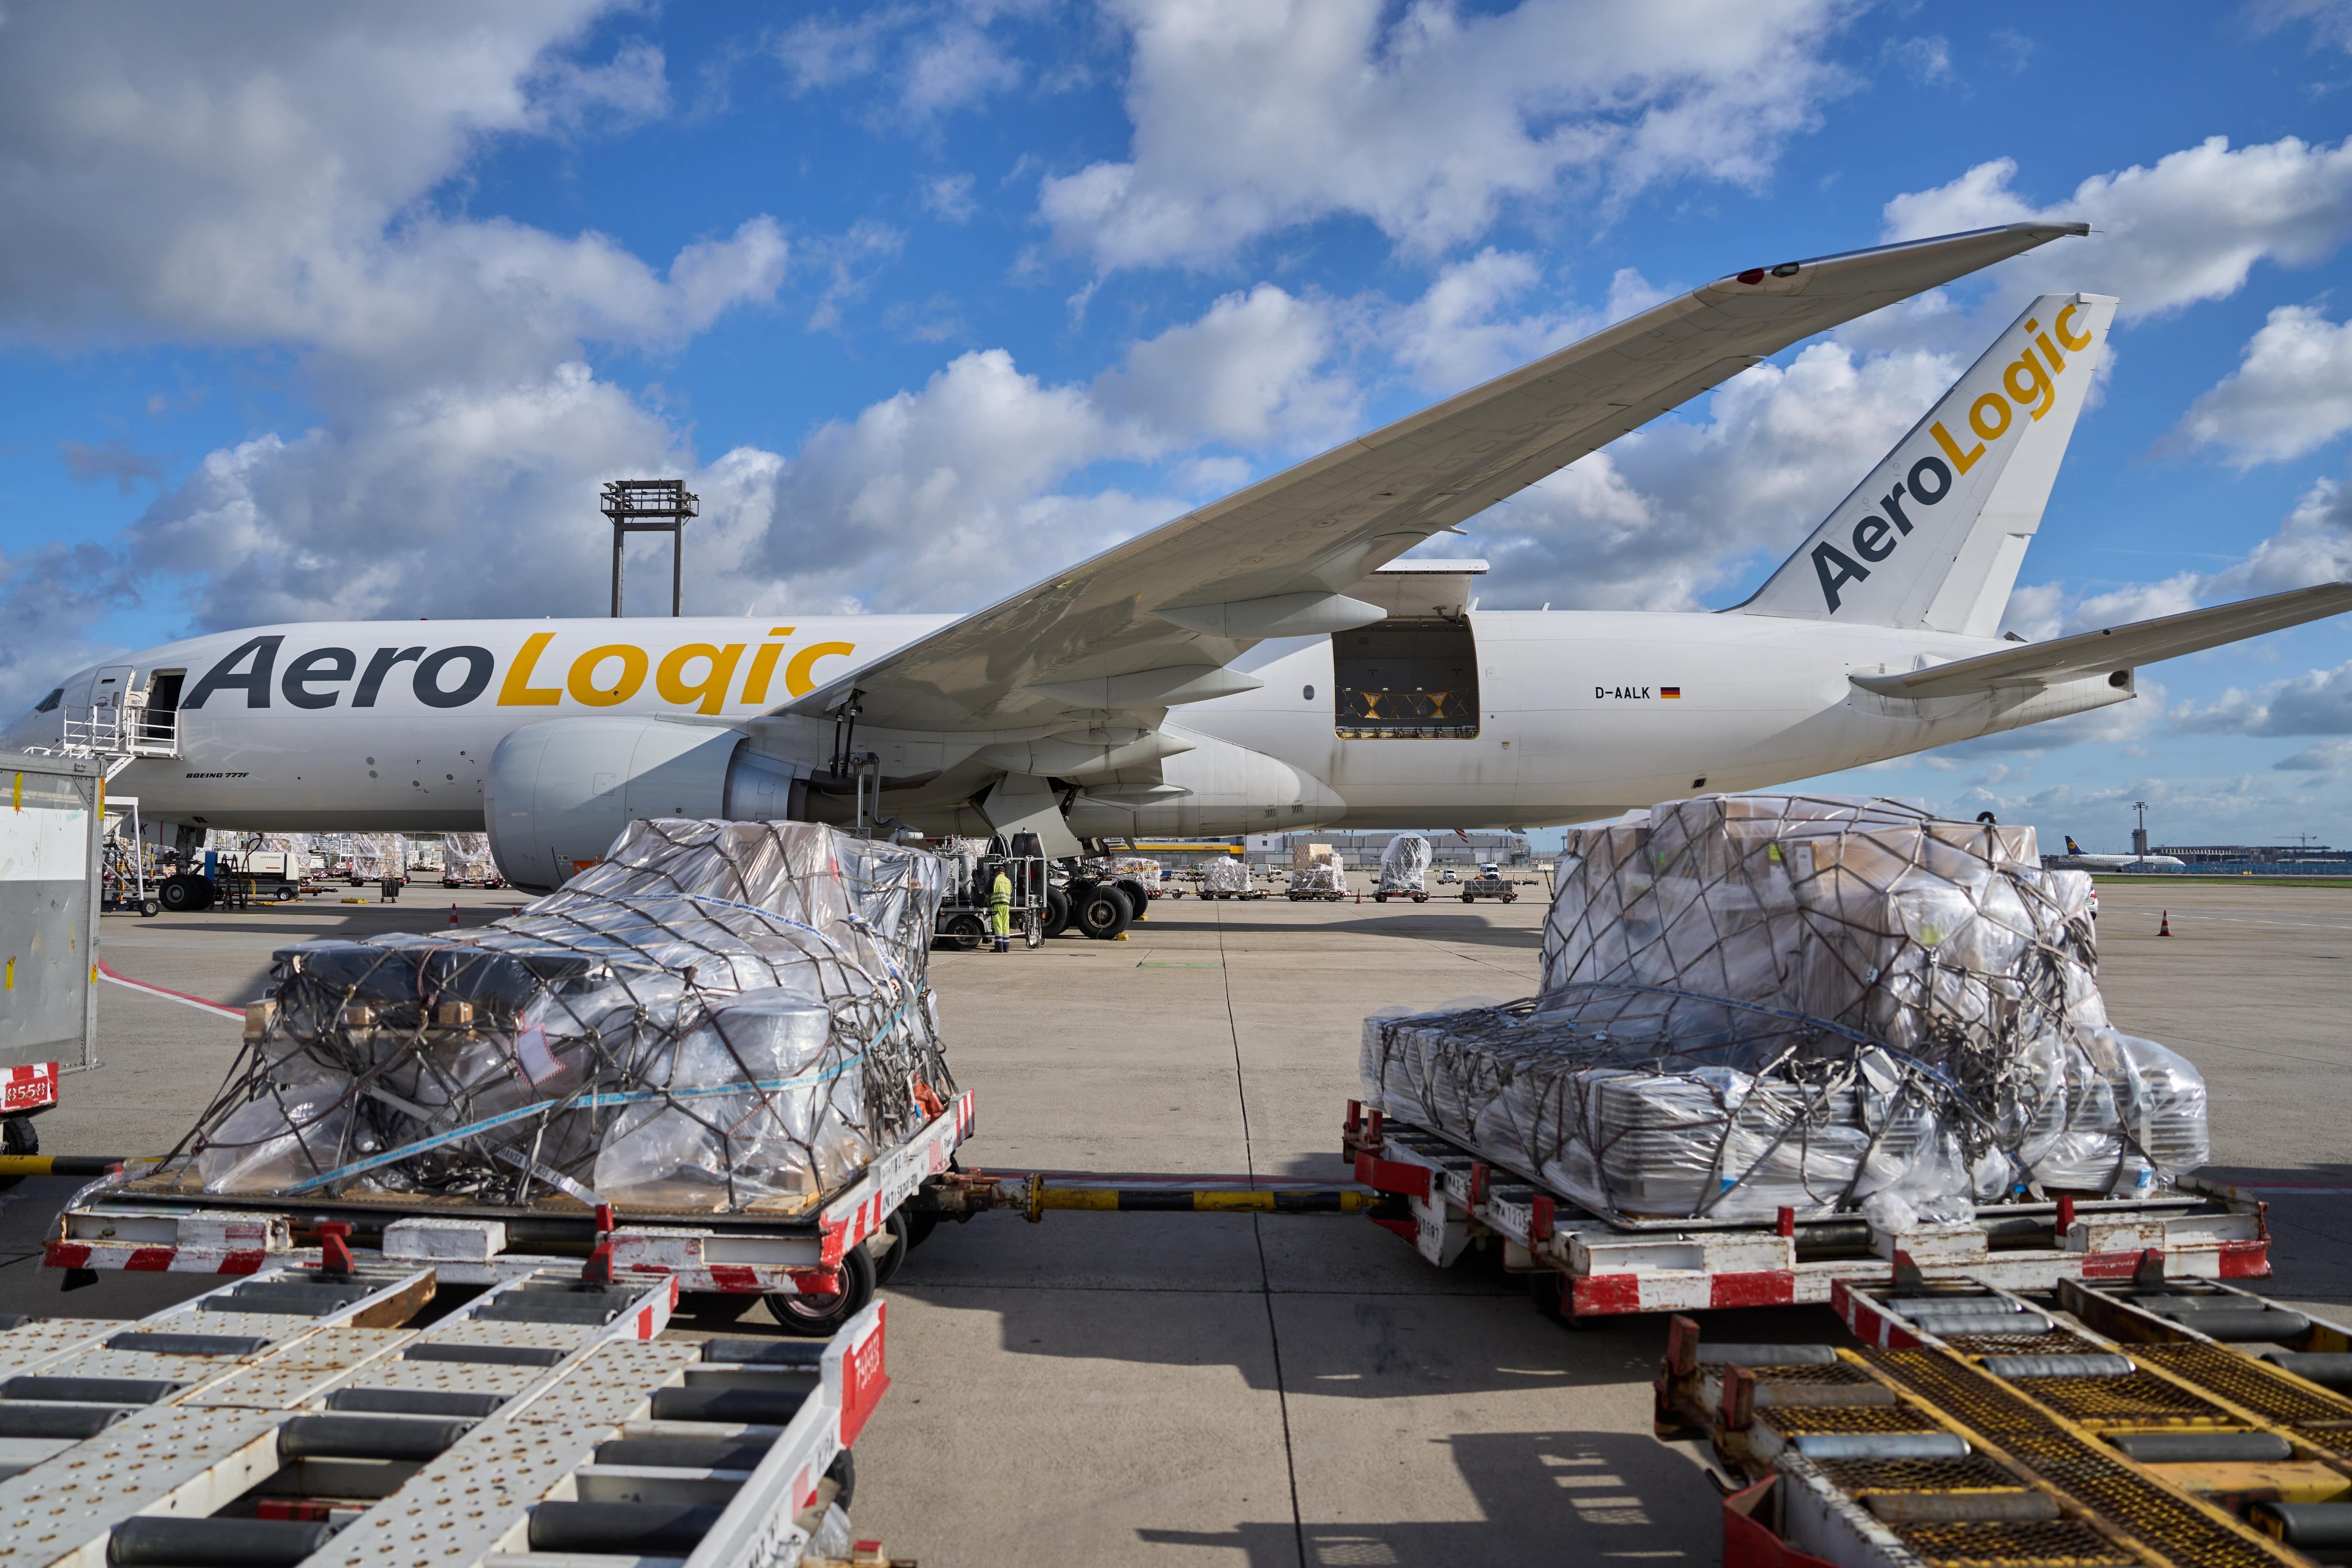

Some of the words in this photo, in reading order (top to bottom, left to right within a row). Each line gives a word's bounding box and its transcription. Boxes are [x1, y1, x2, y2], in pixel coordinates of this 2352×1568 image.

[1811, 303, 2092, 615] AeroLogic
[180, 627, 856, 715] AeroLogic
[1595, 686, 1650, 699] D-AALK
[7, 1082, 45, 1102] 8558
